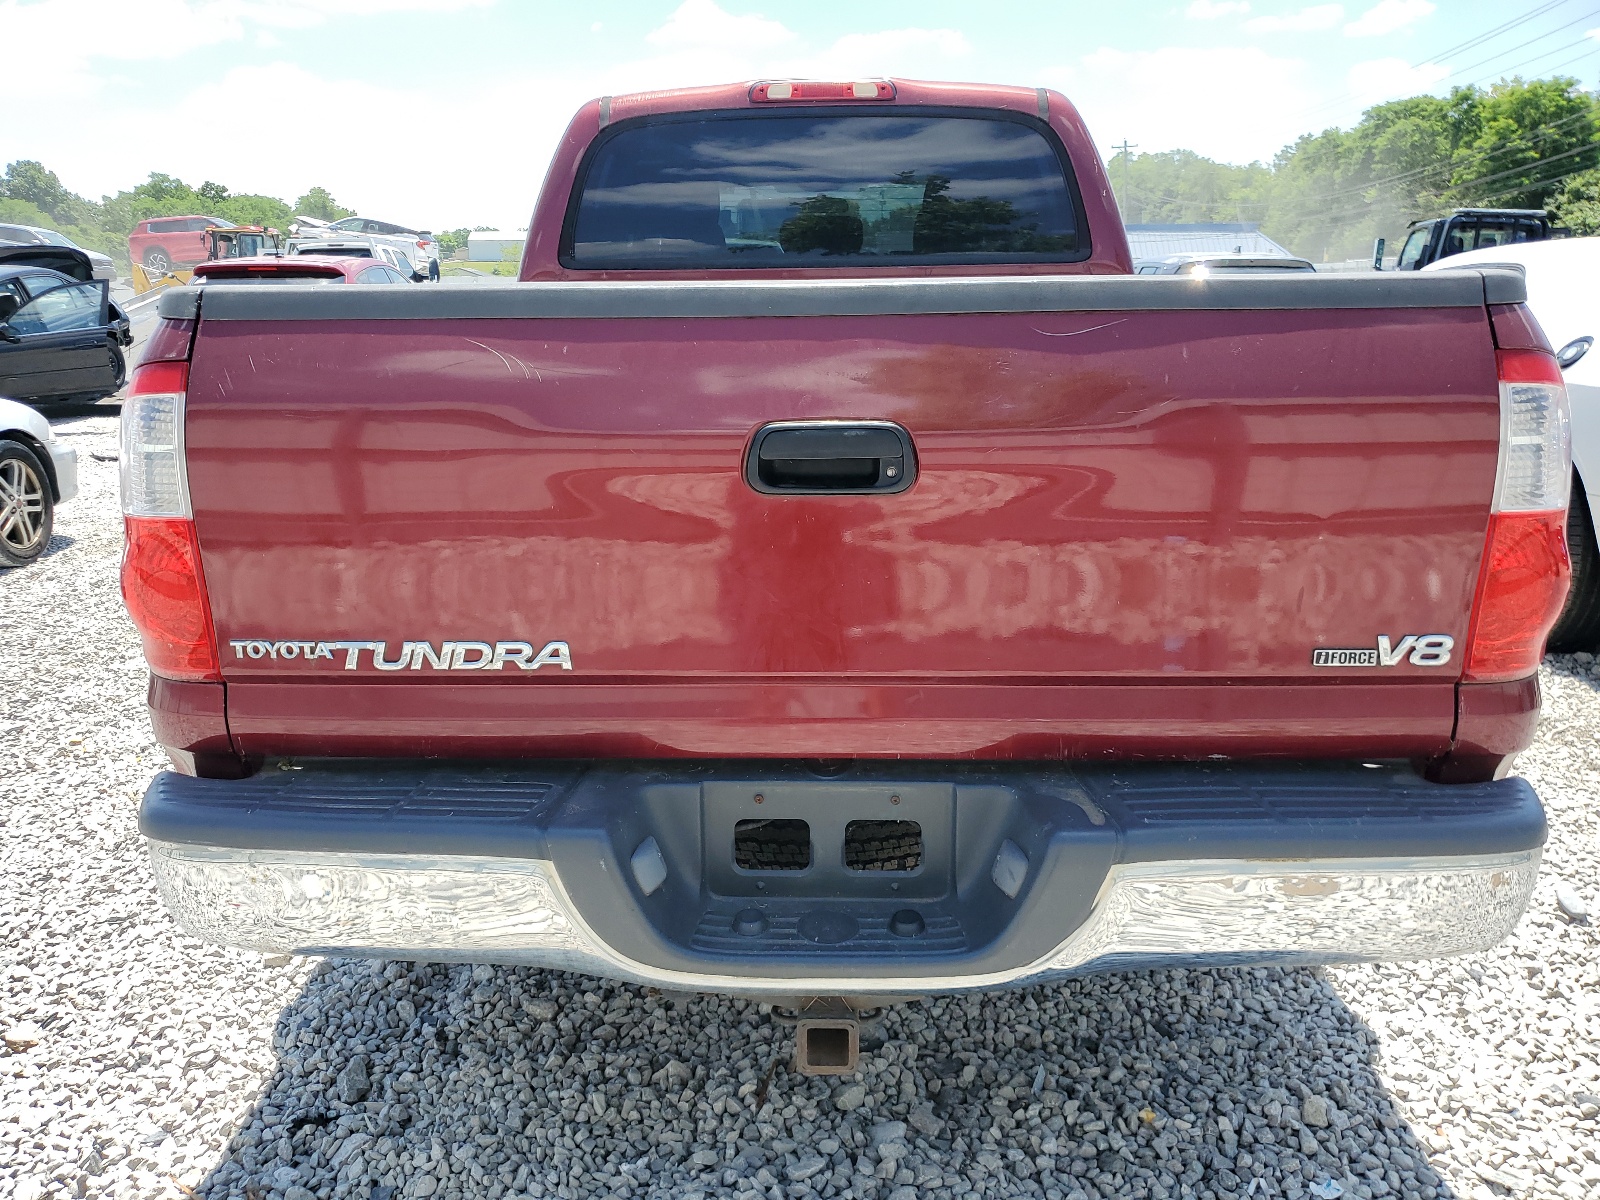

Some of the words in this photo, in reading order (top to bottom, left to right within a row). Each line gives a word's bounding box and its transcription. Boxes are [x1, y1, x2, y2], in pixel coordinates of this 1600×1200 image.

[229, 640, 333, 660] TOYOTA
[335, 641, 573, 671] TUNDRA
[1377, 635, 1455, 666] V8
